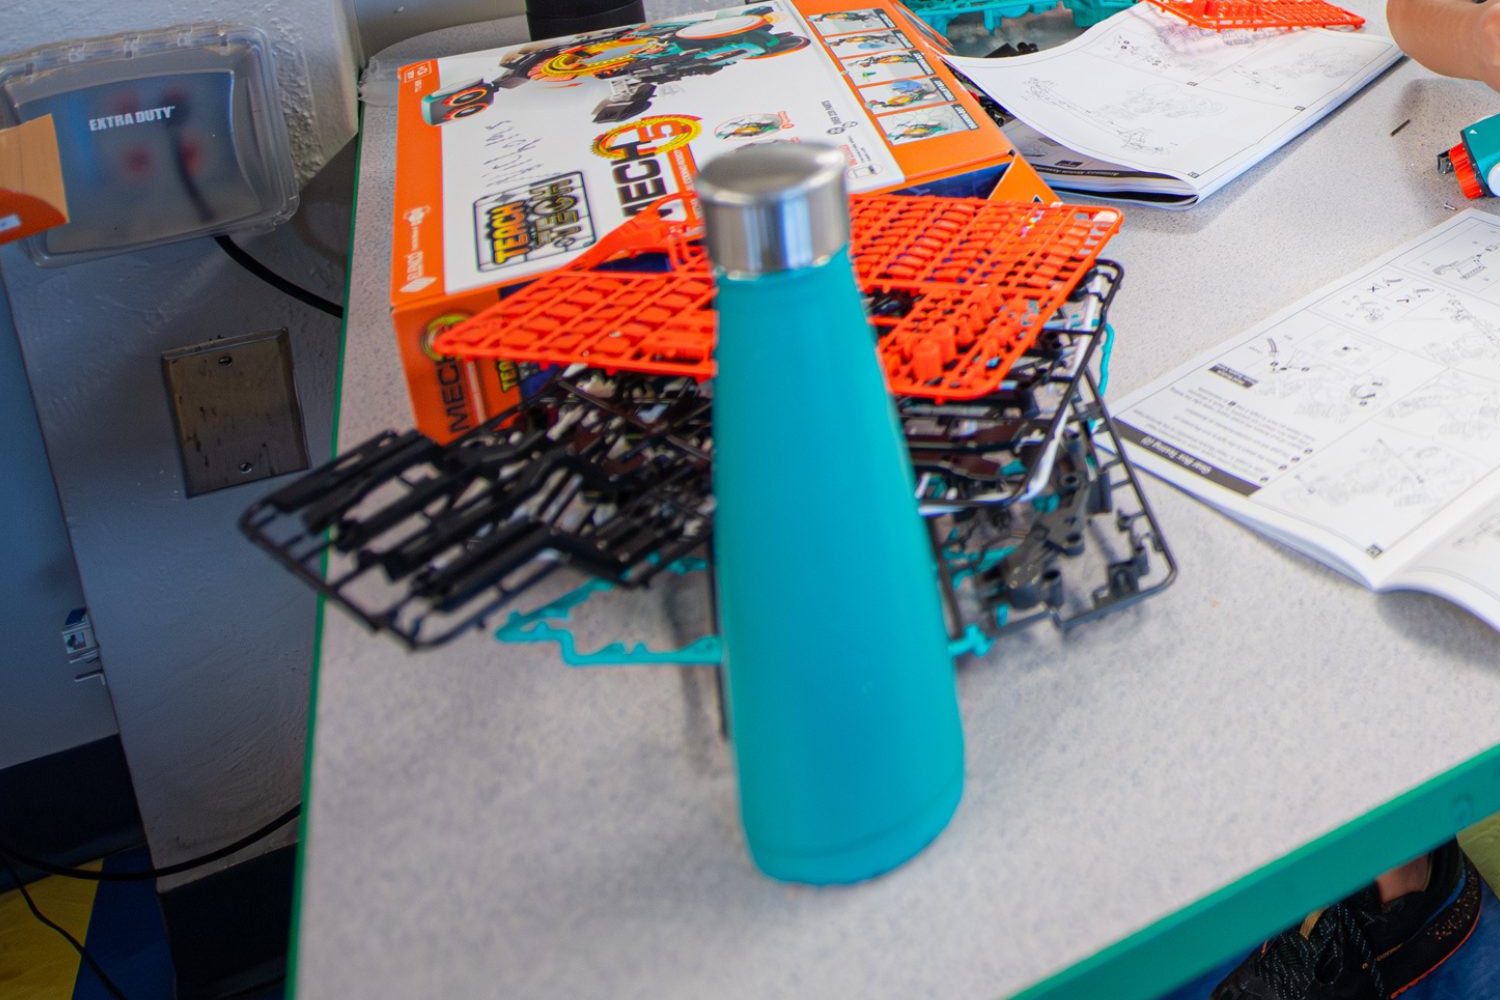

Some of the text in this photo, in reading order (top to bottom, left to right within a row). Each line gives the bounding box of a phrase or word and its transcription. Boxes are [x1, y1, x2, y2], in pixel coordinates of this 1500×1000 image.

[89, 106, 172, 131] EXTRA DUTY
[637, 120, 684, 142] 5
[489, 199, 529, 266] TEACH
[529, 178, 582, 248] TECH
[436, 355, 469, 432] MEC
